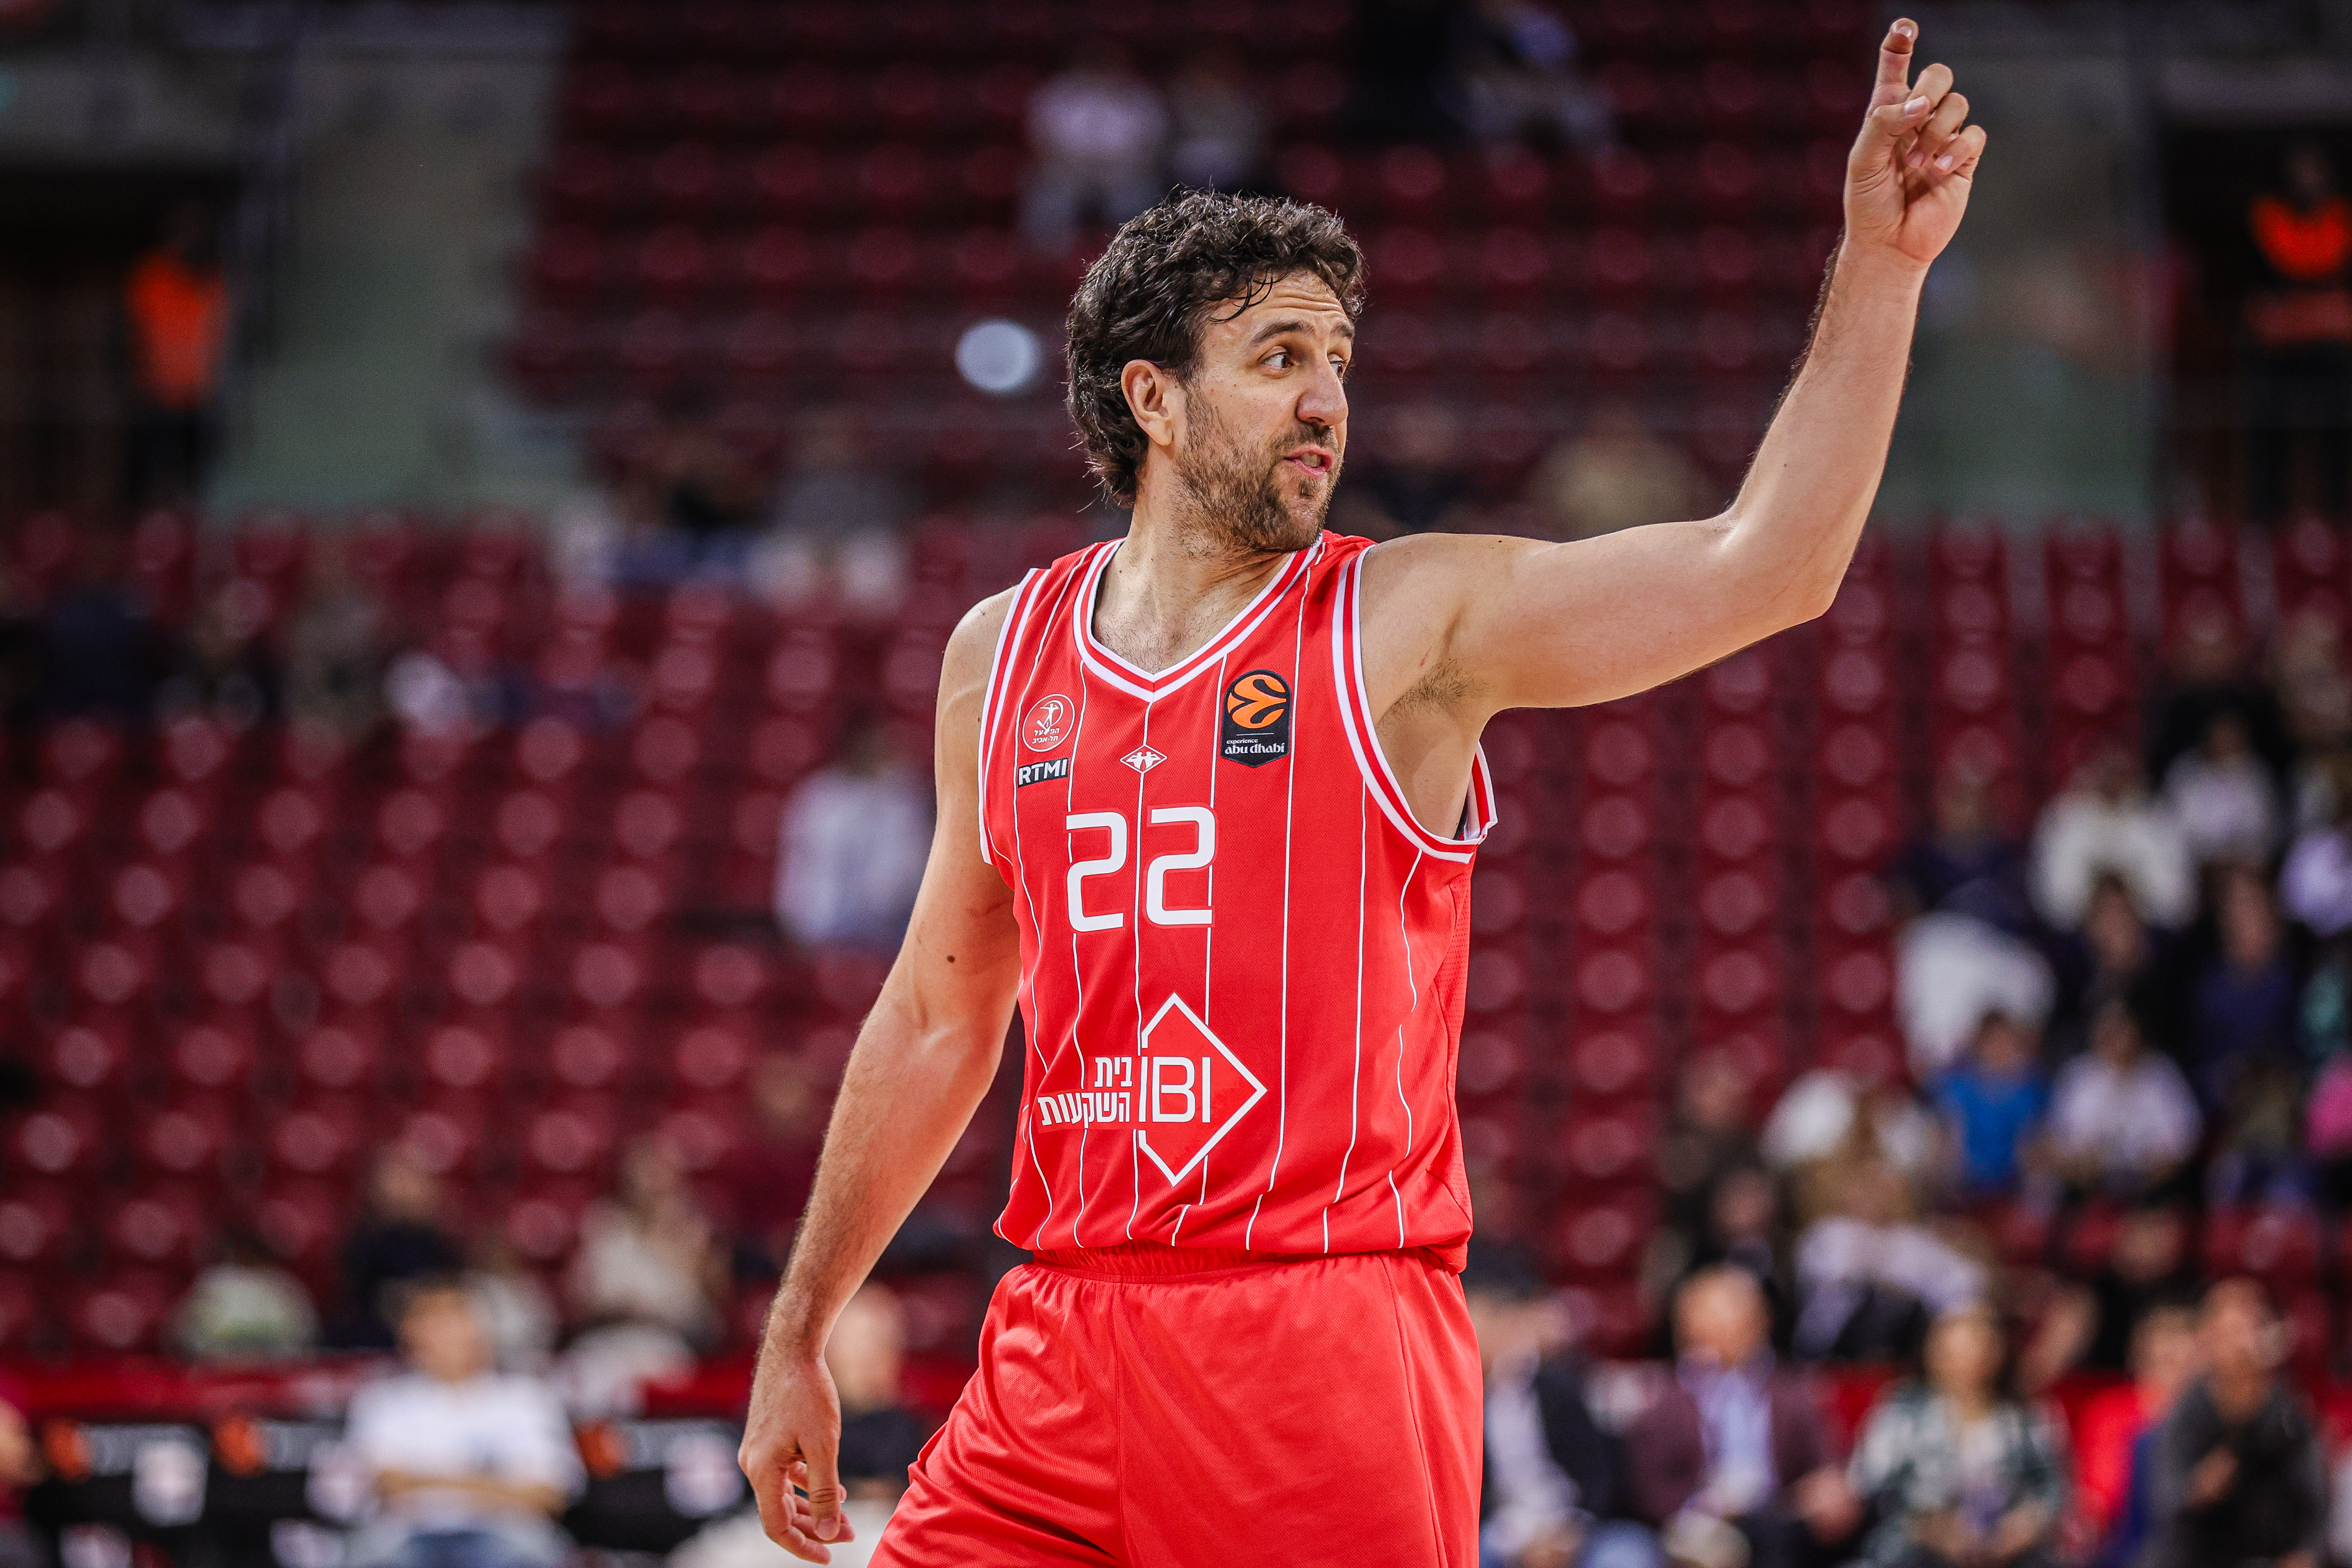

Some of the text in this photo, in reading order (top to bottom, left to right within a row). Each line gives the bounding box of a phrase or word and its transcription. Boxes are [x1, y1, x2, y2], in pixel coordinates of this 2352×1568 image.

[1225, 743, 1285, 754] abu dhabi
[1018, 759, 1068, 785] RTMI
[1066, 806, 1216, 932] 22
[1094, 1056, 1133, 1087] בית
[1138, 1056, 1211, 1123] IBI
[1037, 1092, 1131, 1129] השקעות
